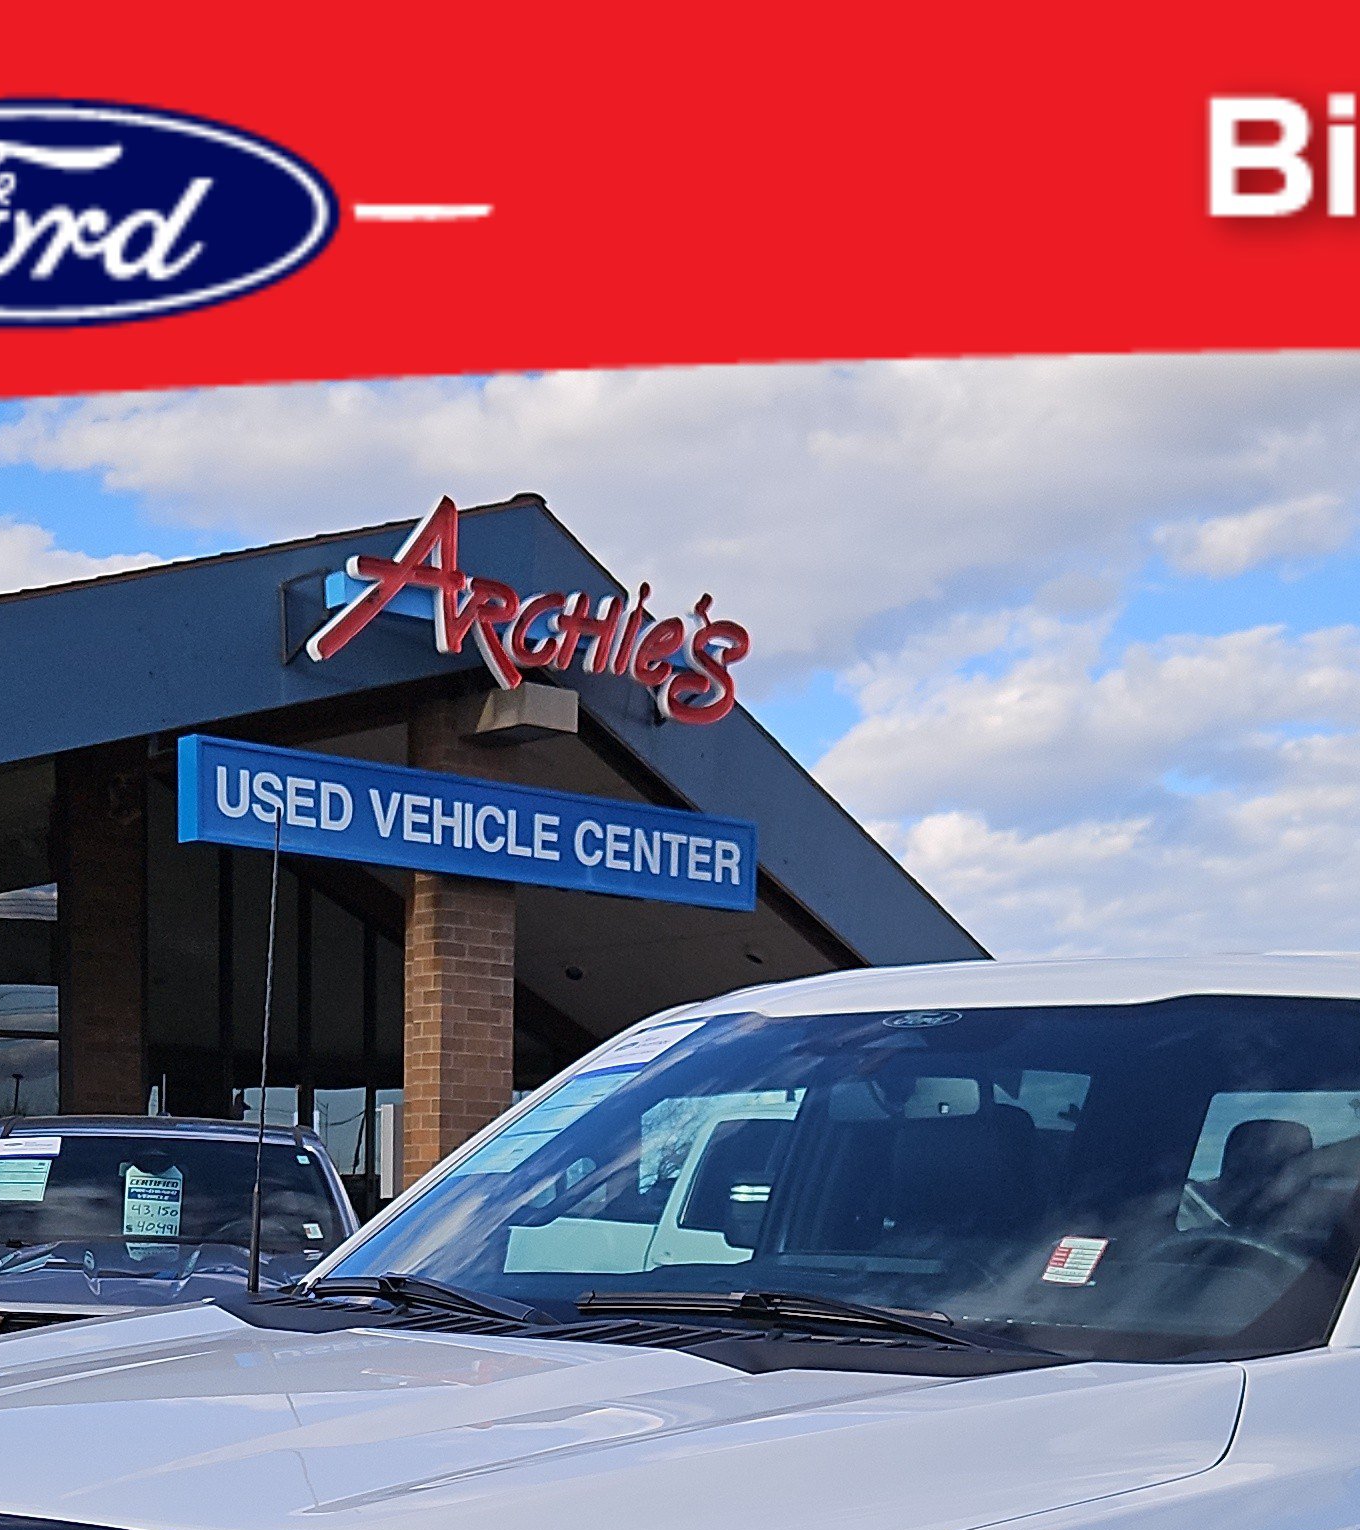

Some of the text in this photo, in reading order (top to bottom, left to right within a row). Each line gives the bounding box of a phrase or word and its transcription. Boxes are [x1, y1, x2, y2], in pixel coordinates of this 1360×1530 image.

[216, 765, 741, 886] USED VEHICLE CENTER
